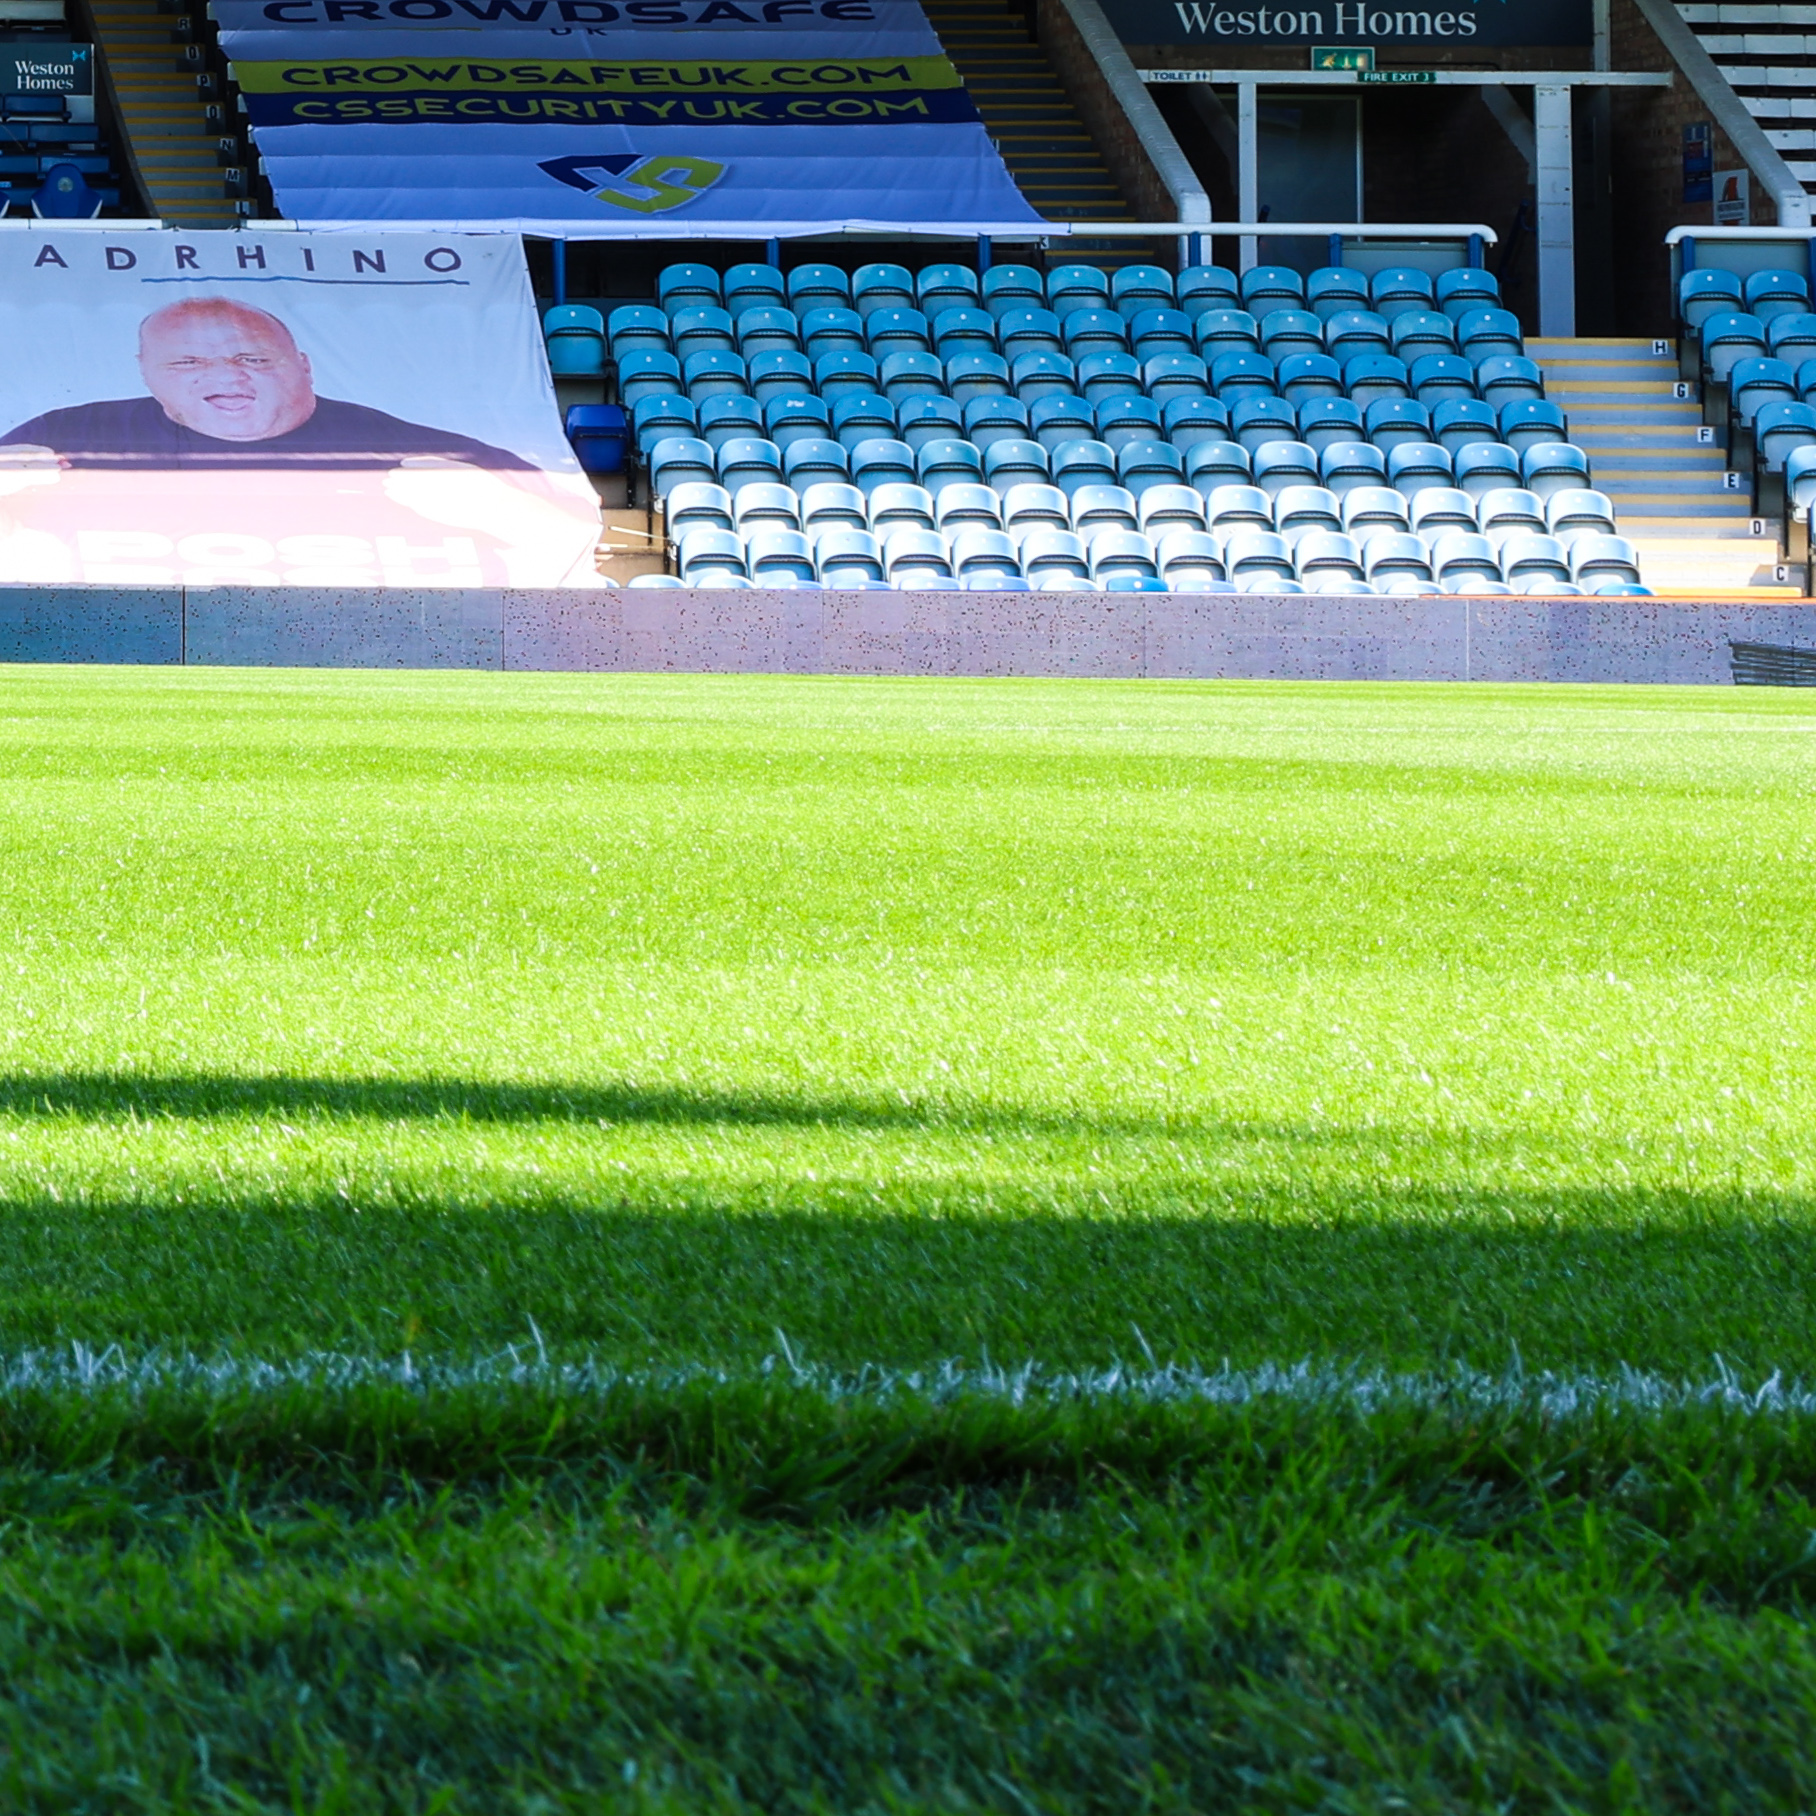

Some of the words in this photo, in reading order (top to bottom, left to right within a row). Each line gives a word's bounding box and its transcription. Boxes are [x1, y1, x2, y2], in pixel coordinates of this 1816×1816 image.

[1174, 2, 1323, 35] Weston
[1335, 2, 1477, 36] Homes
[15, 61, 74, 75] Weston
[280, 64, 913, 86] CROWDSAFEUK.COM
[16, 75, 74, 90] Homes
[1153, 72, 1192, 81] TOILET
[1364, 73, 1387, 82] FIRE
[1392, 73, 1418, 82] EXIT
[292, 96, 930, 120] CSSECURITYUK.COM
[223, 140, 231, 150] N
[227, 170, 238, 180] M
[1656, 341, 1666, 353] H
[1677, 384, 1686, 398] G
[1700, 429, 1710, 441] F
[1728, 474, 1736, 487] E
[1753, 520, 1762, 534] D
[1777, 567, 1785, 581] C
